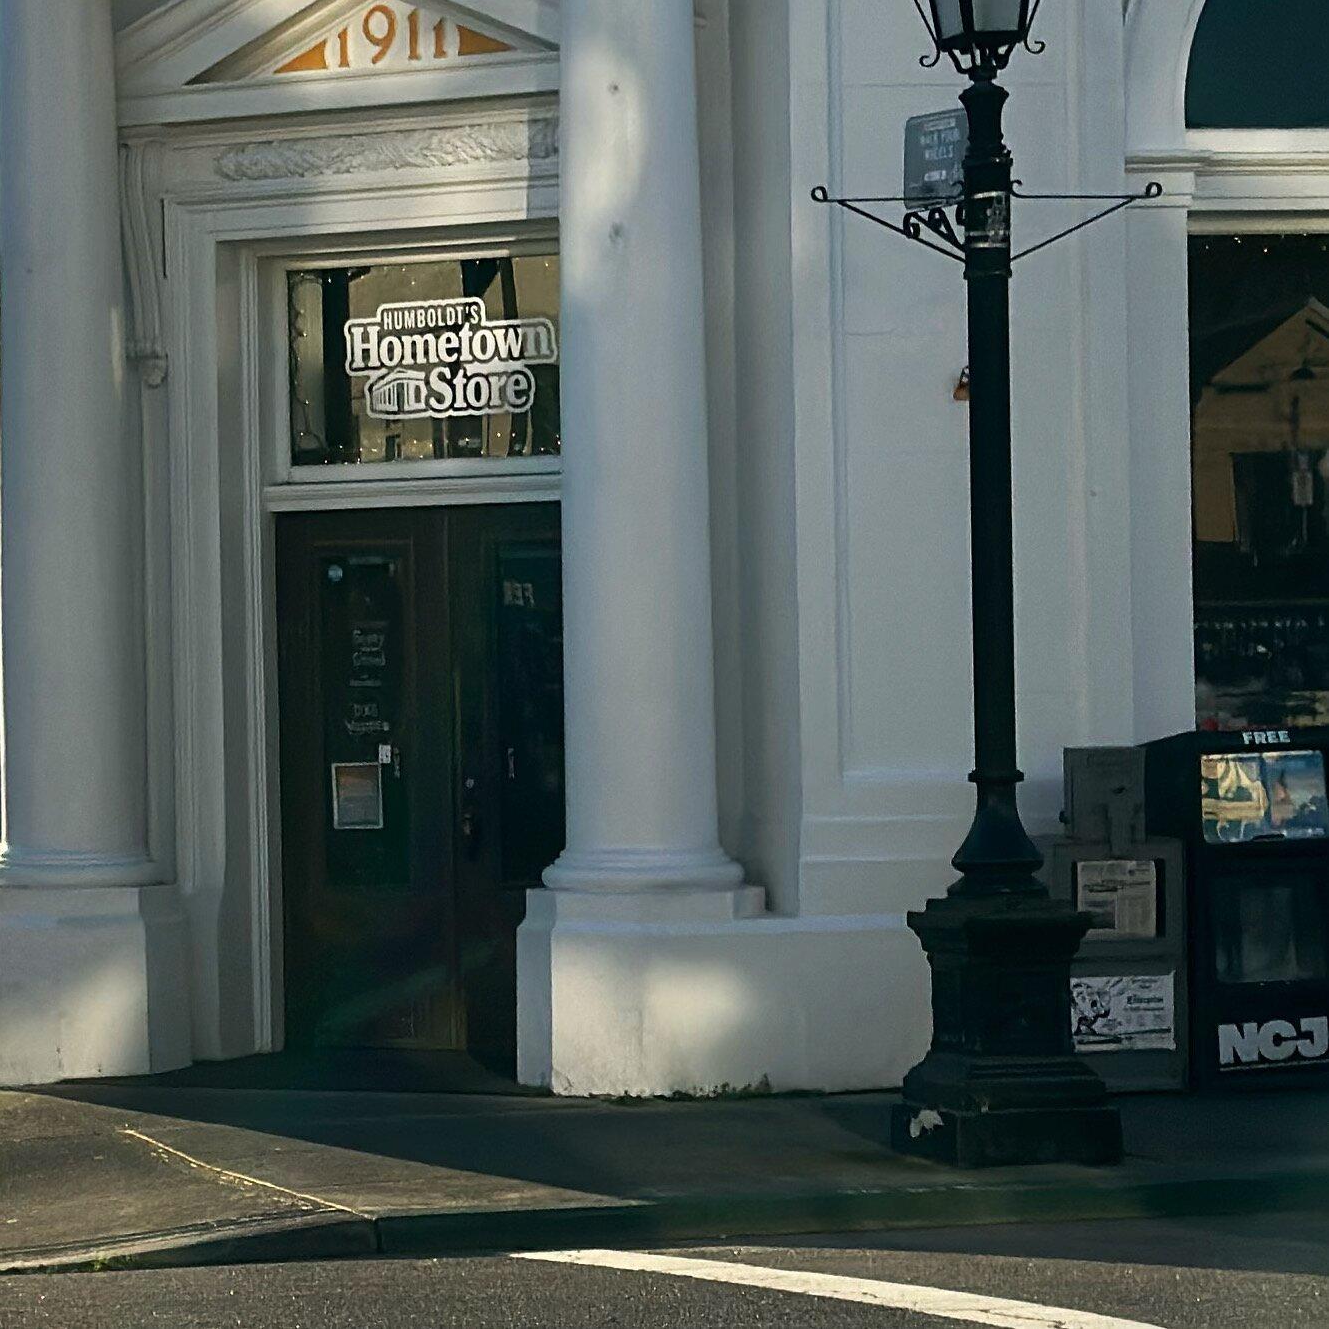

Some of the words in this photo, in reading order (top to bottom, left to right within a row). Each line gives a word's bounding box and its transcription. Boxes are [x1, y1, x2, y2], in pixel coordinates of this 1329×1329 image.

[338, 4, 448, 68] 1911
[383, 304, 479, 330] HUMBOLDT'S
[350, 322, 551, 369] Hometown
[428, 368, 528, 411] Store
[1242, 730, 1291, 745] FREE
[1218, 1015, 1328, 1065] NCJ
